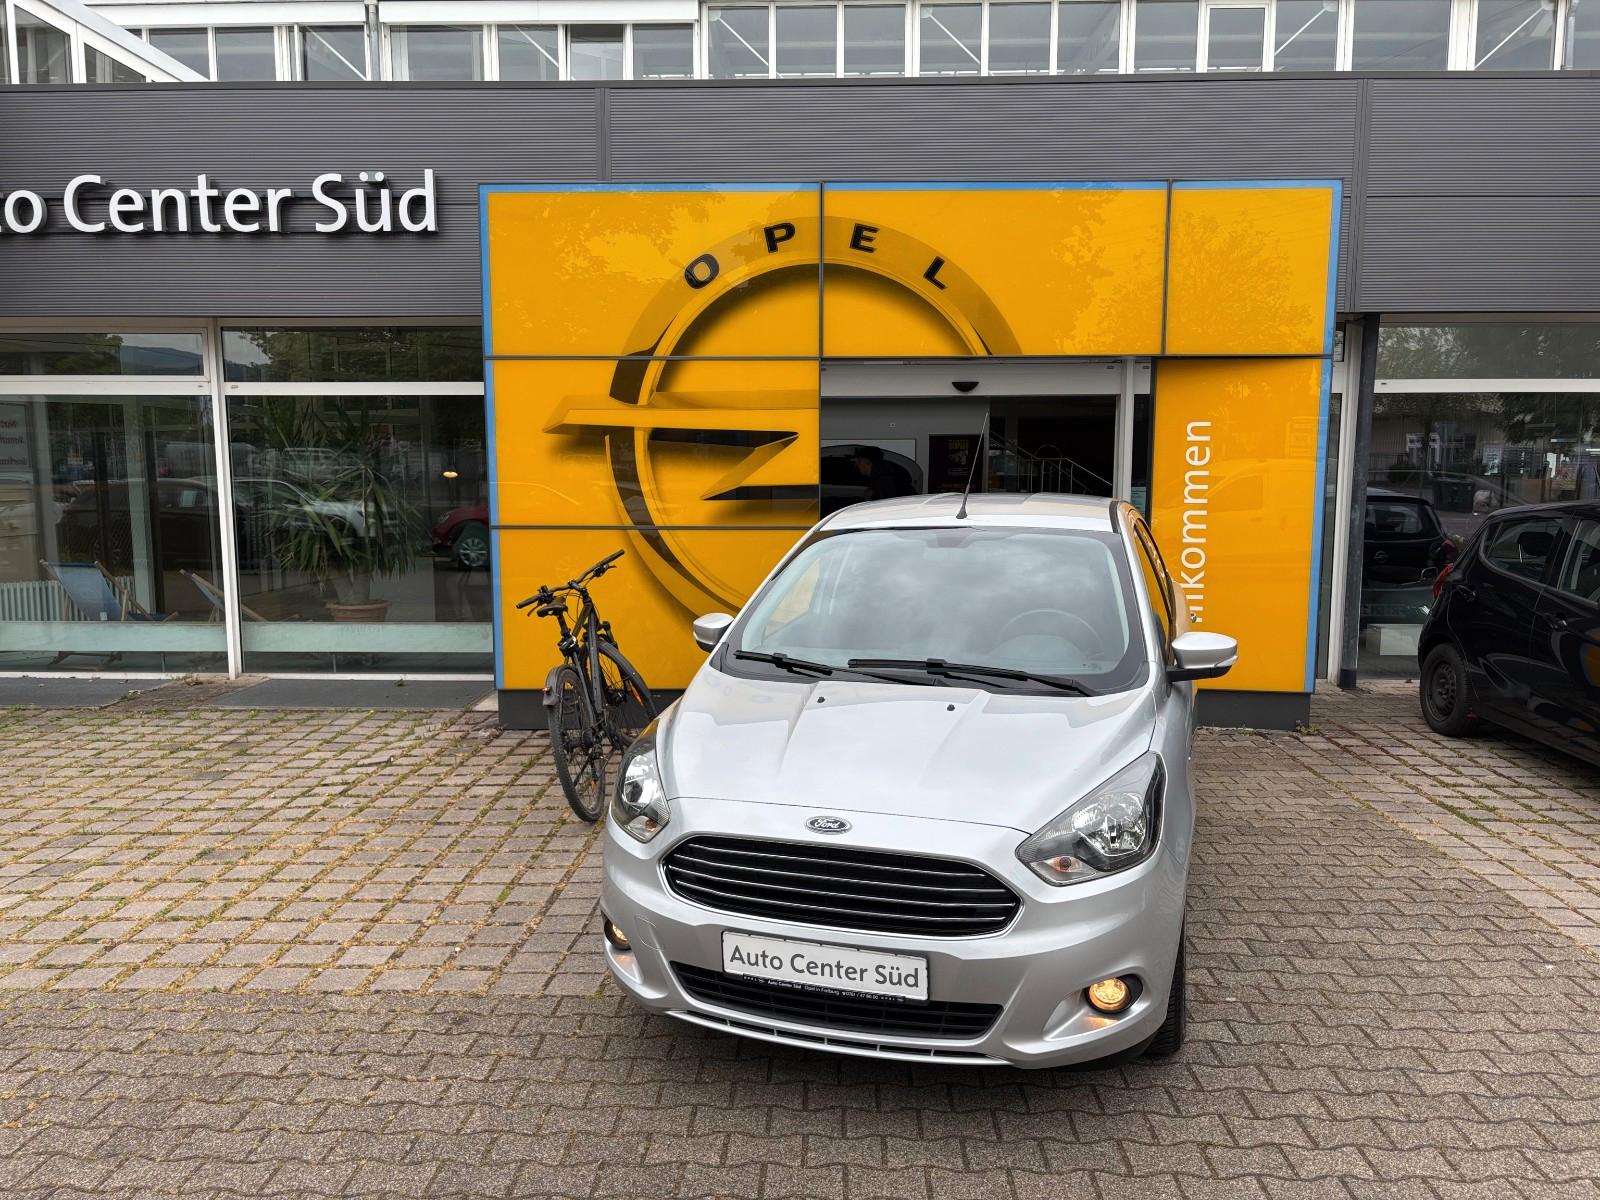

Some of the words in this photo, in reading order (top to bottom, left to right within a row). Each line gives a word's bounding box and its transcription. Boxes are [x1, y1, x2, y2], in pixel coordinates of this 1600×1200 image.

[0, 189, 46, 233] o
[63, 173, 293, 233] Center
[311, 168, 438, 233] Süd
[684, 222, 948, 290] OPEL
[729, 944, 783, 970] Auto
[789, 953, 868, 982] Center
[874, 964, 919, 988] Süd
